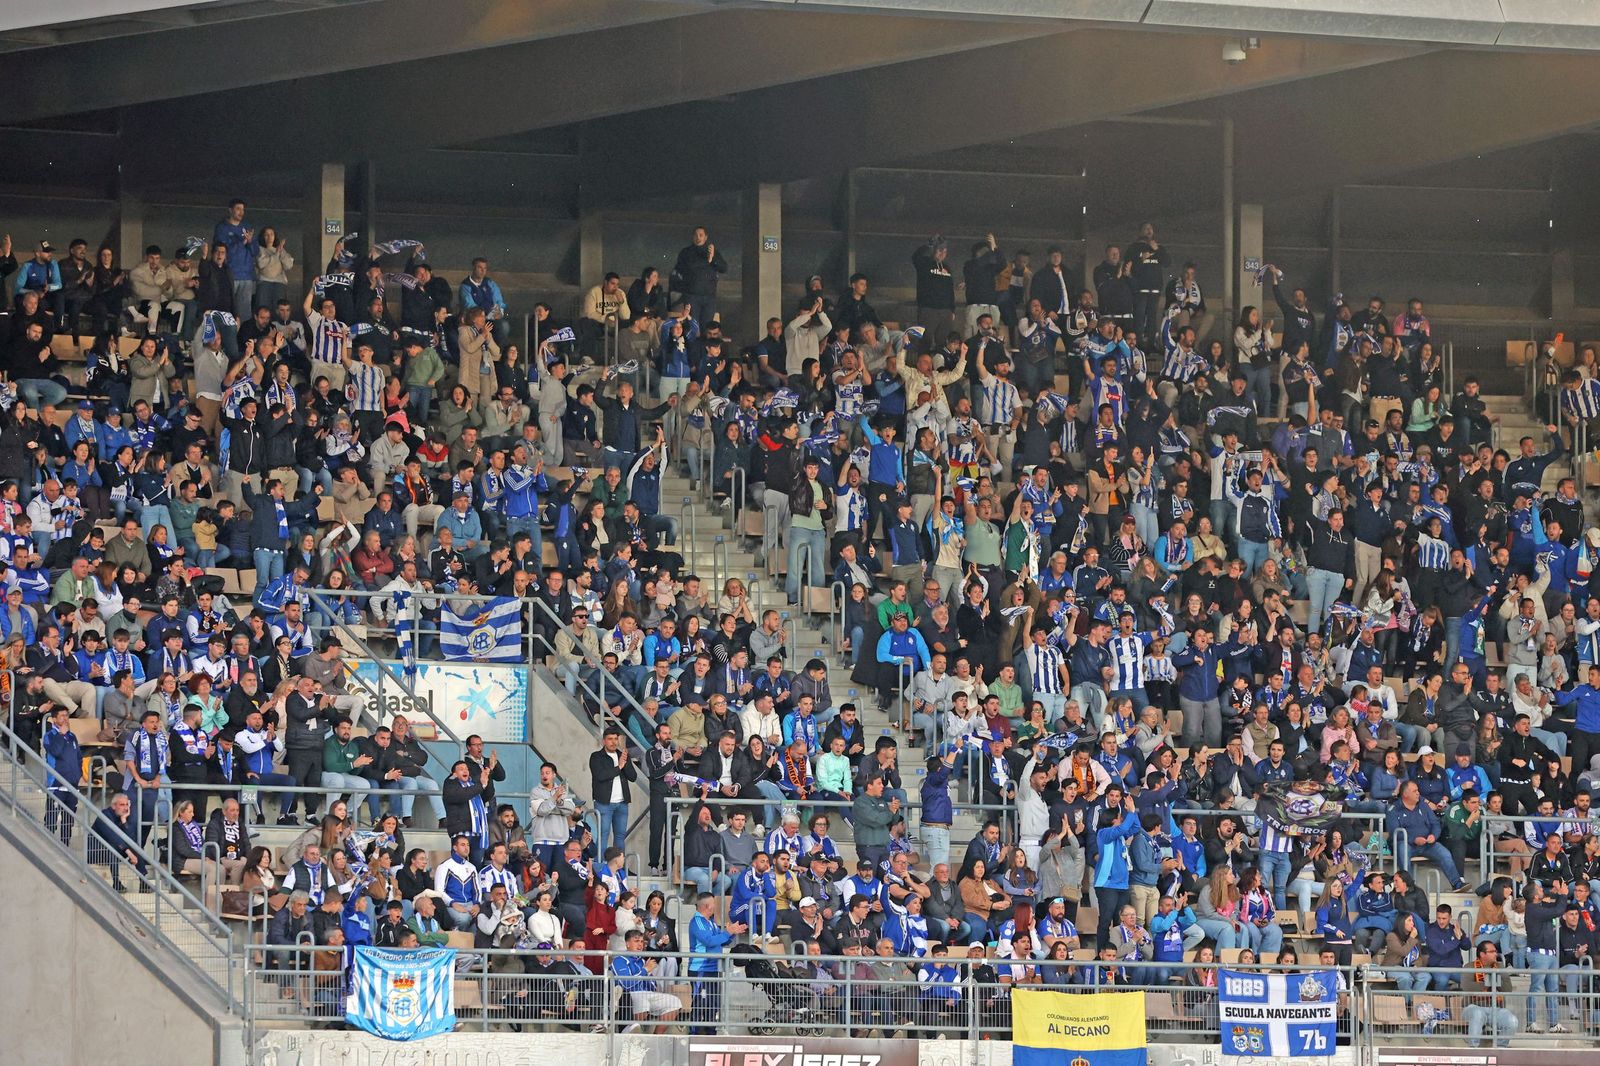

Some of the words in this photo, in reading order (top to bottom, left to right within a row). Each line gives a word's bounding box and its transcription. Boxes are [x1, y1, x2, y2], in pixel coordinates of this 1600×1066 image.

[326, 225, 340, 233] 344
[242, 793, 256, 801] 244
[1225, 977, 1265, 997] 1889
[1046, 1013, 1080, 1022] COLOMBIANOS
[1225, 1007, 1265, 1018] SCUOLA
[1266, 1007, 1332, 1019] NAVEGANTE
[1047, 1023, 1061, 1034] AL
[1064, 1025, 1110, 1037] DECANO
